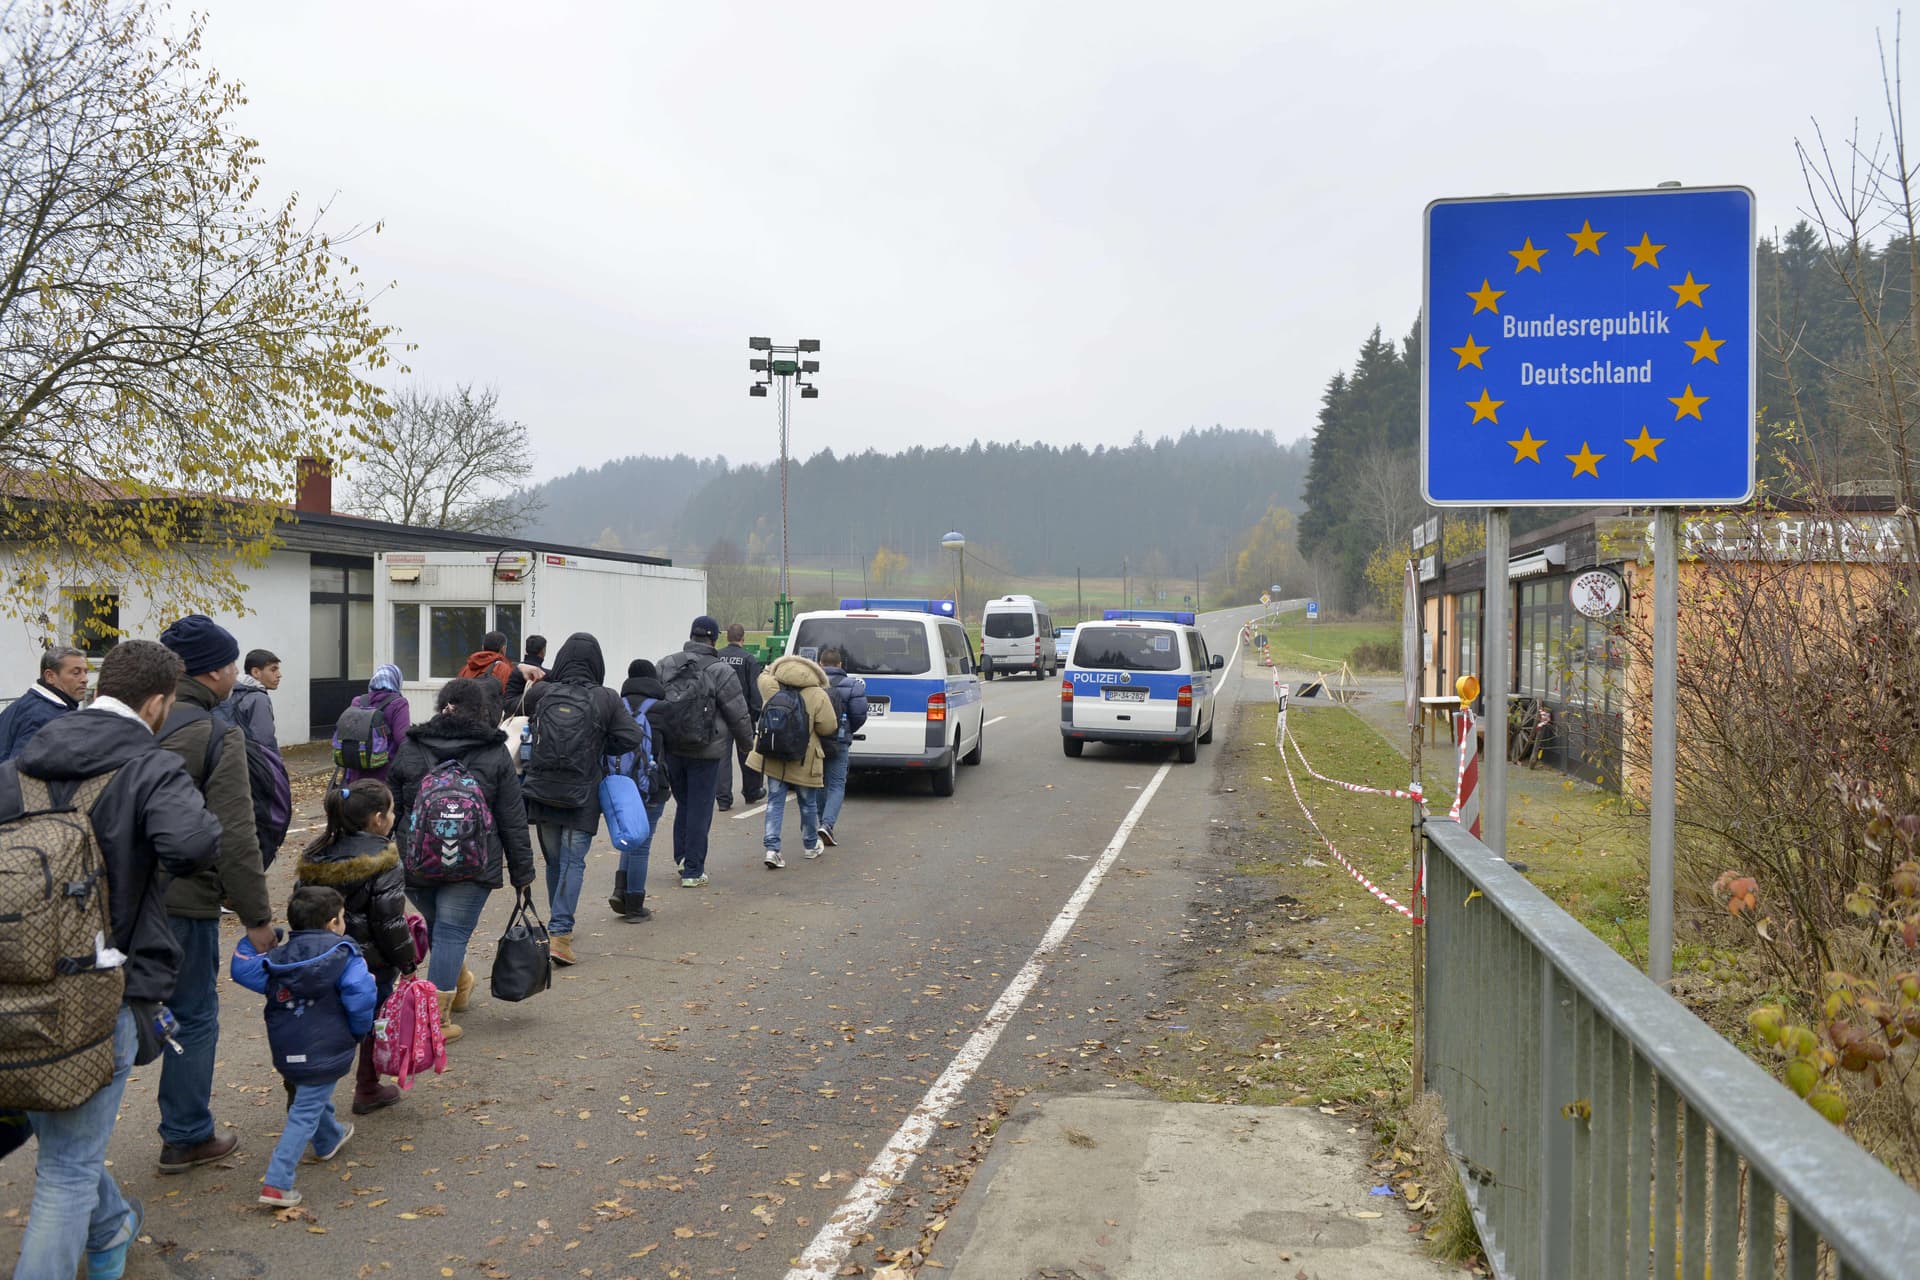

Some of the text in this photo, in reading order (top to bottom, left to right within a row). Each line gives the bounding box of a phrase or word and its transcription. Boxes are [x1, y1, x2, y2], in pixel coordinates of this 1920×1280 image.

[1503, 310, 1671, 342] Bundesrepublik
[1521, 359, 1652, 386] Deutschland
[719, 656, 744, 665] OLIZEI
[1073, 673, 1118, 684] POLIZEI
